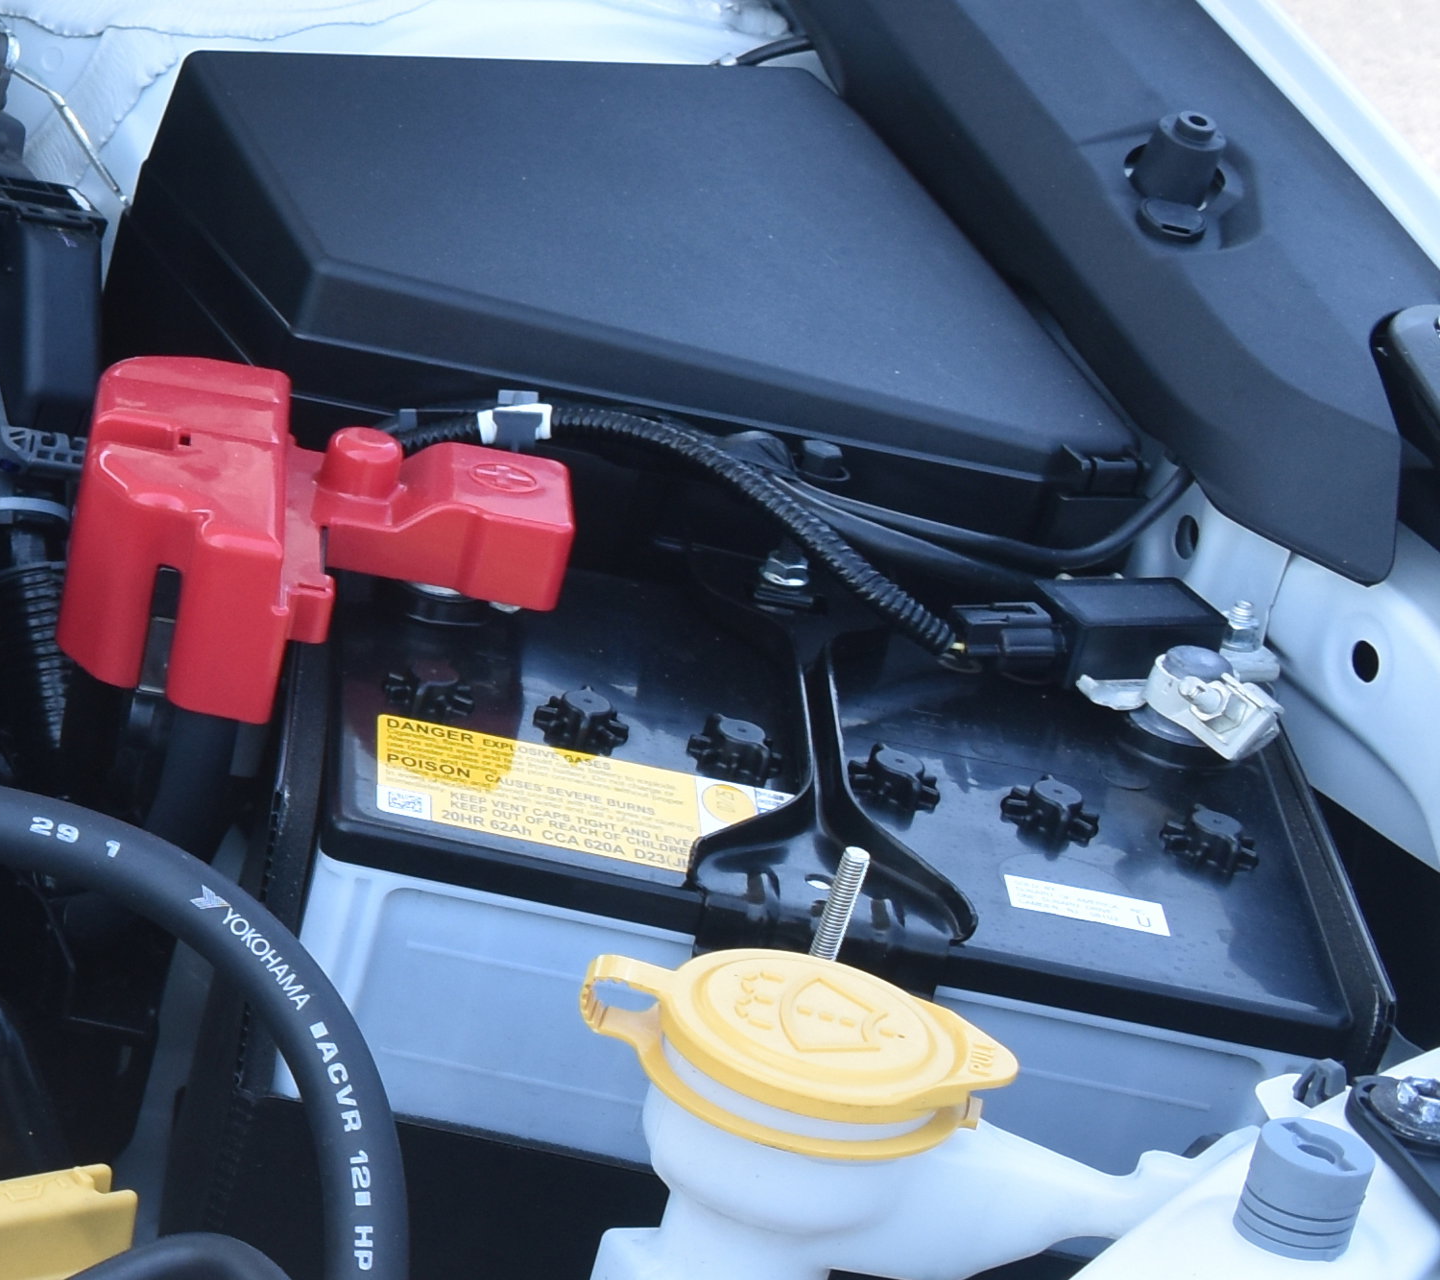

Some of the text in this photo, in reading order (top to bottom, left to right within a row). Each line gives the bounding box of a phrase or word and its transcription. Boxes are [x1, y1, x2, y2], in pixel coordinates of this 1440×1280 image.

[387, 718, 610, 771] DANGER EXPLOSIVE GASES
[387, 753, 656, 816] POISON CAUSES SEVERE BURNS
[29, 816, 79, 843] 29
[105, 840, 121, 858] 1
[442, 809, 484, 827] 20HR
[490, 819, 531, 837] 62Ah
[542, 829, 579, 846] CCA
[584, 838, 625, 855] 620A
[450, 791, 691, 848] KEEP VENT CAPS TIGHT AND LEVE
[450, 800, 688, 856] KEEP OUT OF REACH OF CHILDRE
[1136, 915, 1152, 928] U
[222, 907, 311, 1011] YOKOHAMA
[316, 1041, 374, 1271] ACVR 12 HP
